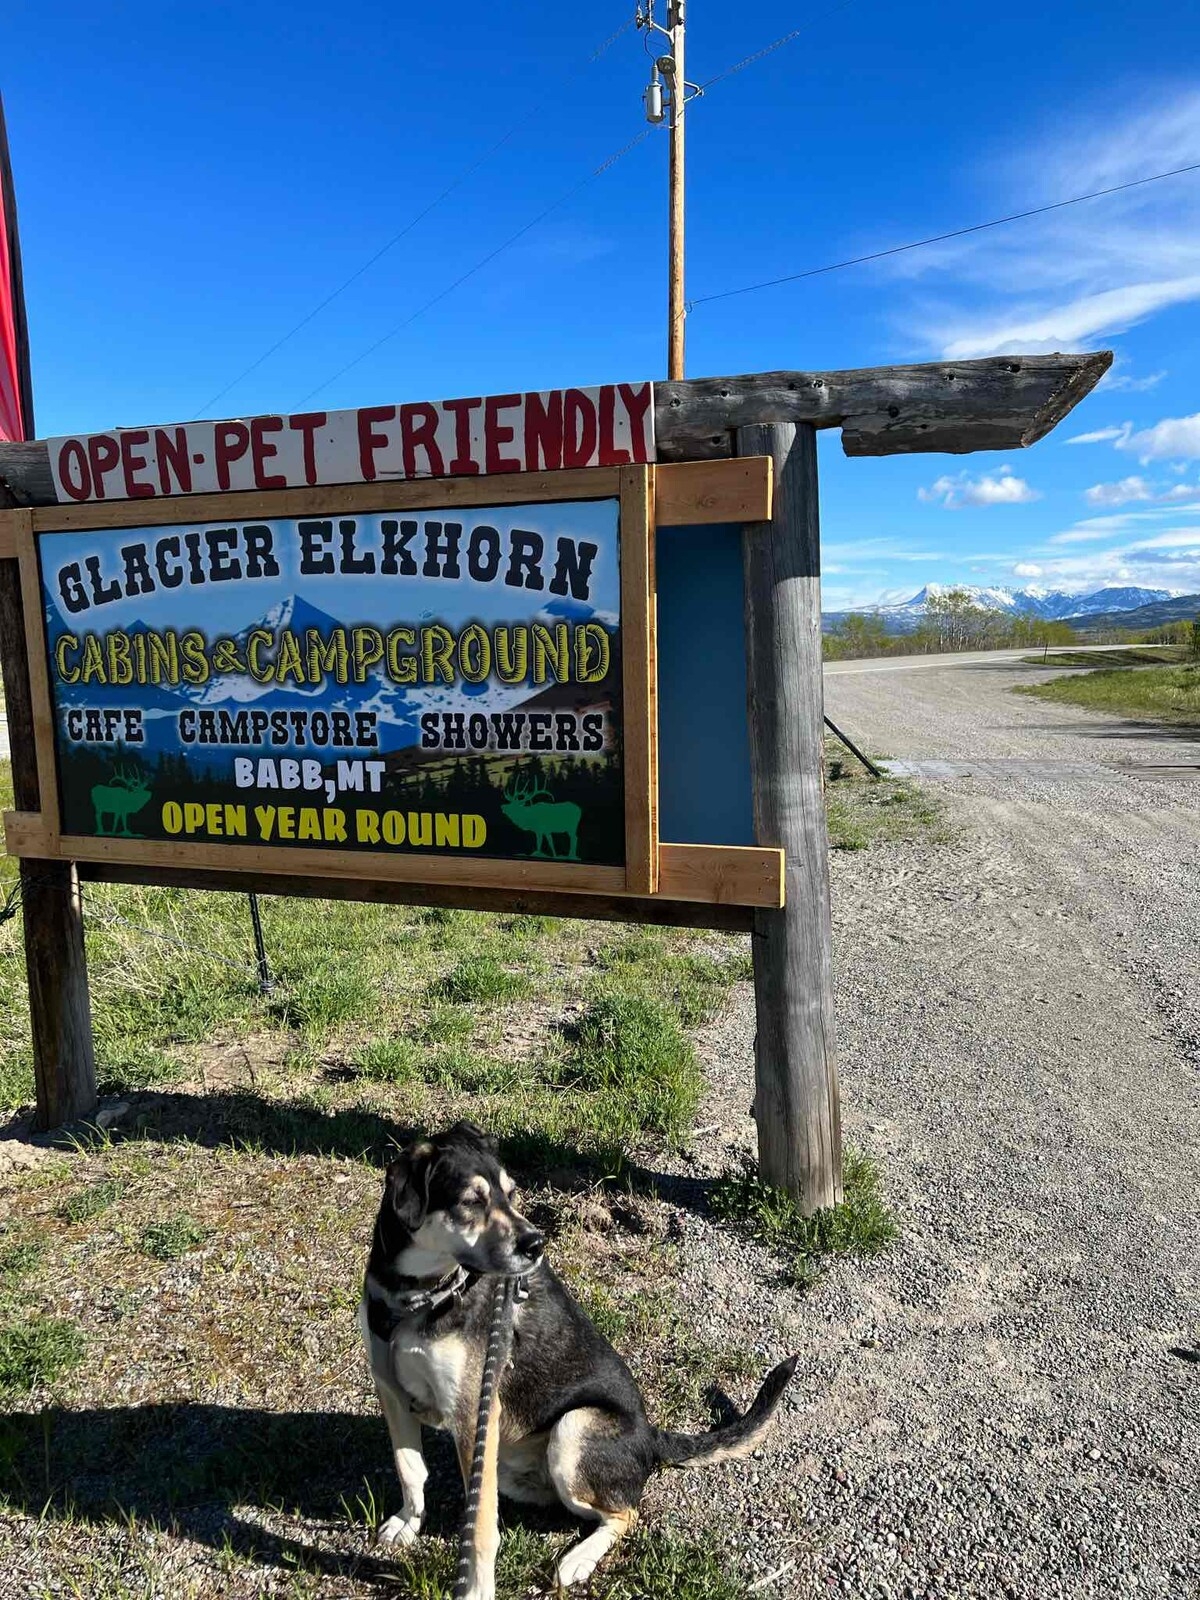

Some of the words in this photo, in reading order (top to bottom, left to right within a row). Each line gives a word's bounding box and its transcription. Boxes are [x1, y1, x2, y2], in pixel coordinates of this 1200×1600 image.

[358, 381, 652, 481] FRIENDLY
[58, 524, 280, 613] GLACIER
[298, 520, 599, 601] ELKHORN
[67, 709, 144, 743] CAFE
[179, 710, 378, 748] CAMPSTORE
[420, 712, 605, 752] SHOWERS
[161, 801, 247, 837] OPEN
[254, 806, 347, 843] YEAR
[356, 809, 487, 848] ROUND
